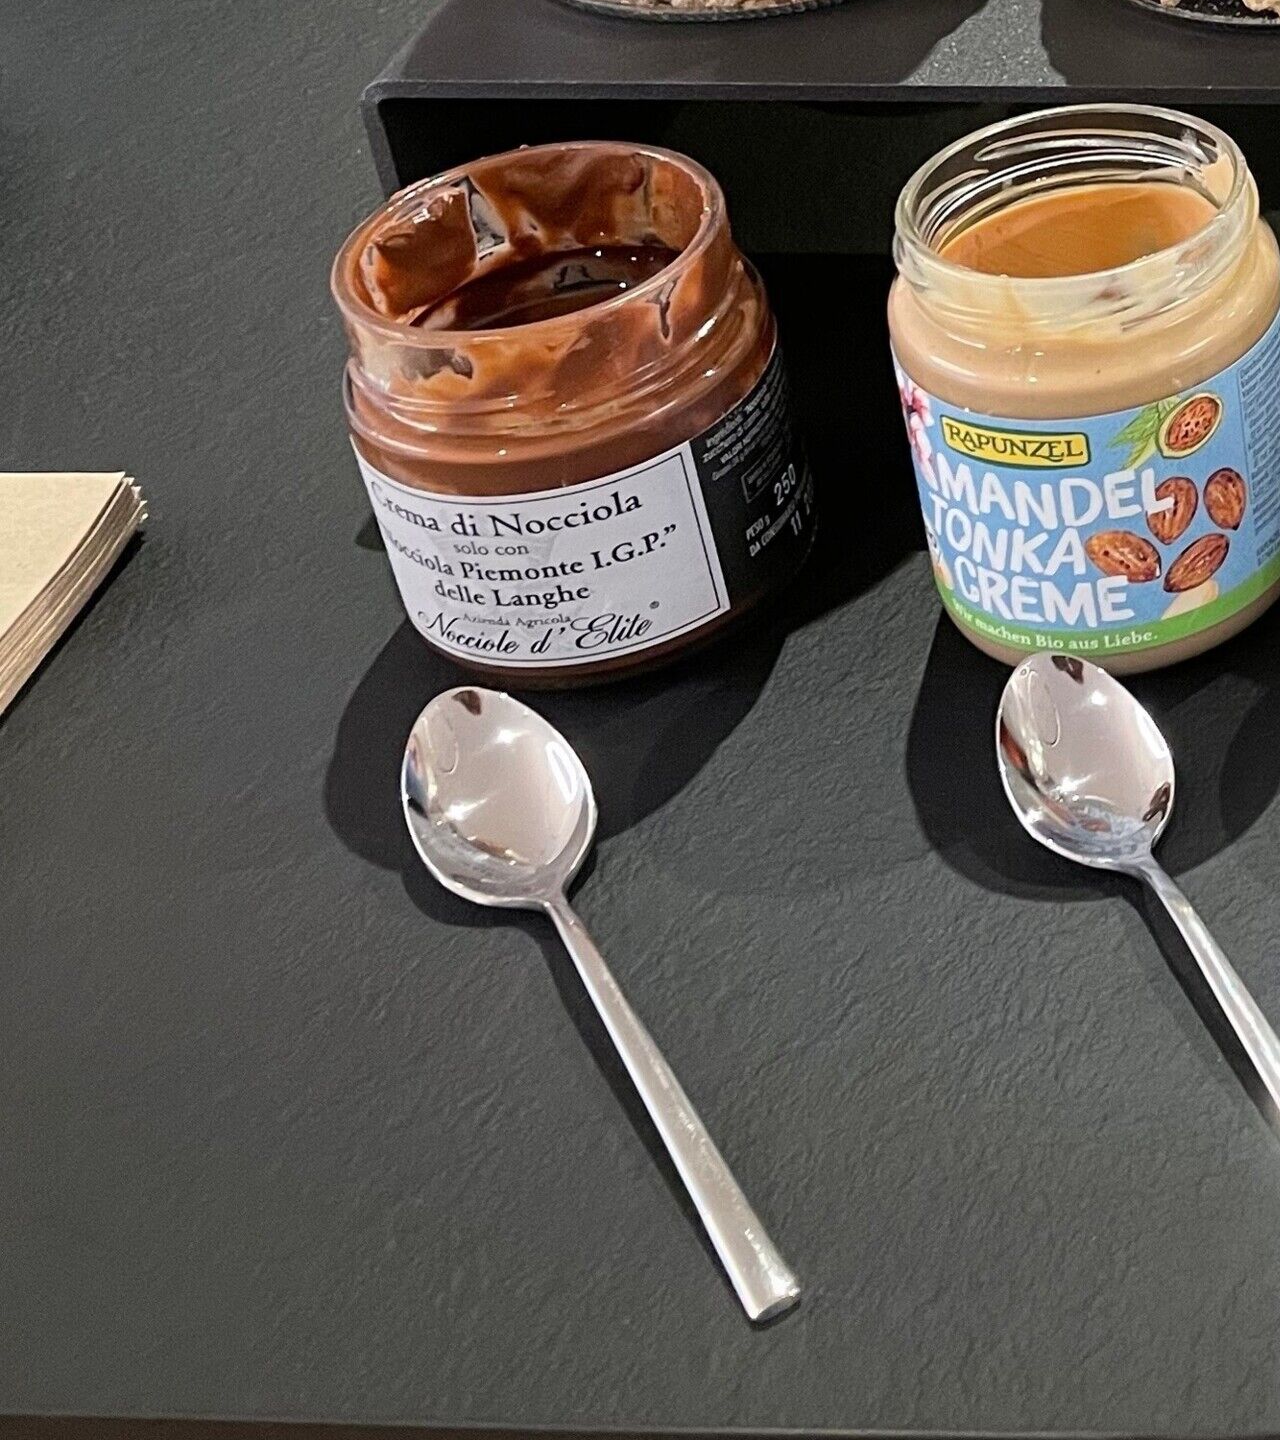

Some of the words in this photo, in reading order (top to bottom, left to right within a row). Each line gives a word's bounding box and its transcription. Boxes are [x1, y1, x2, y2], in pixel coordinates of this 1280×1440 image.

[946, 422, 1084, 462] RAPUNZEL
[773, 462, 797, 506] 250
[936, 451, 1174, 530] MANDEL
[370, 480, 442, 532] Crema
[451, 513, 479, 537] di
[489, 490, 643, 537] Nocciola
[453, 540, 489, 555] solo
[495, 543, 530, 556] con
[929, 491, 1088, 575] TONKA
[460, 560, 584, 581] Piemonte
[435, 580, 486, 606] delle
[493, 584, 592, 609] Langhe
[953, 556, 1136, 628] CREME
[417, 610, 520, 654] Nocciole
[515, 614, 572, 629] Agricola
[975, 618, 1032, 646] machen
[1035, 634, 1065, 650] Bio
[1068, 639, 1099, 650] aus
[1103, 630, 1159, 649] Liebe.
